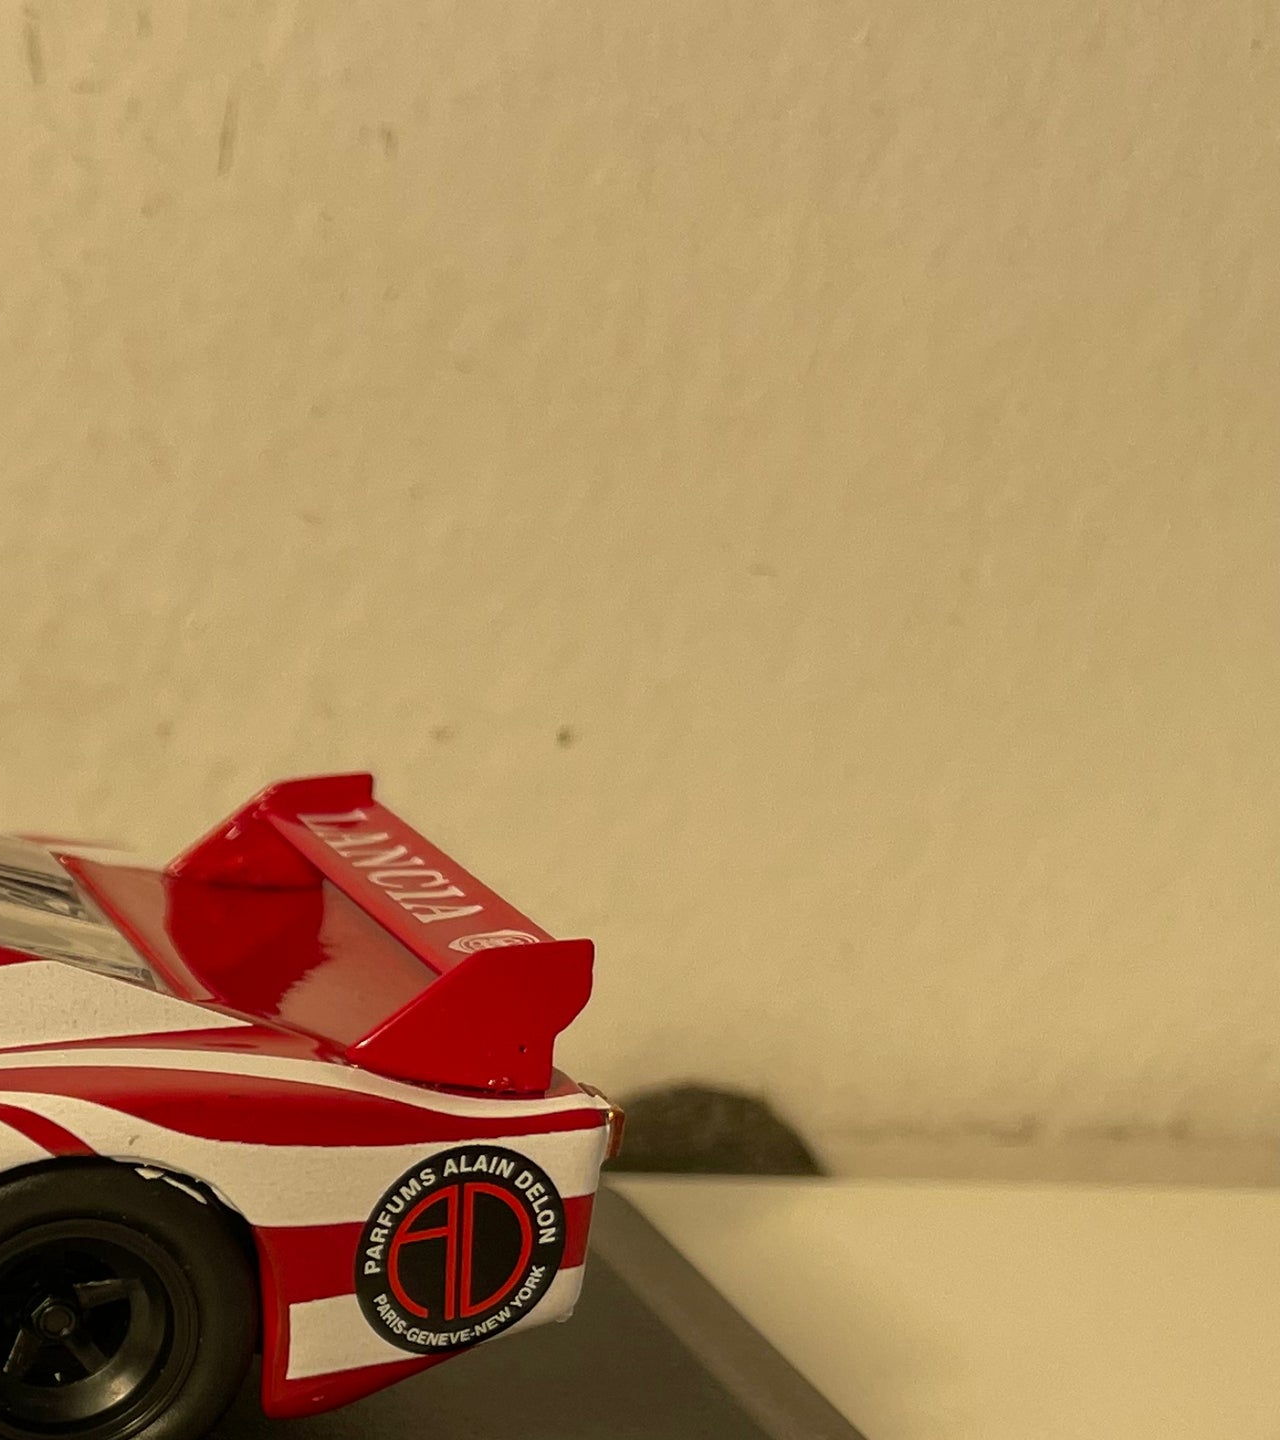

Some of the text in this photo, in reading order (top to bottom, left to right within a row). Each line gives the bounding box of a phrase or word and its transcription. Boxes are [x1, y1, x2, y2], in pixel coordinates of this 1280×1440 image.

[297, 809, 483, 924] LANCIA
[364, 1154, 556, 1275] PARFUMS ALAIN DELON
[510, 1265, 546, 1309] YORK
